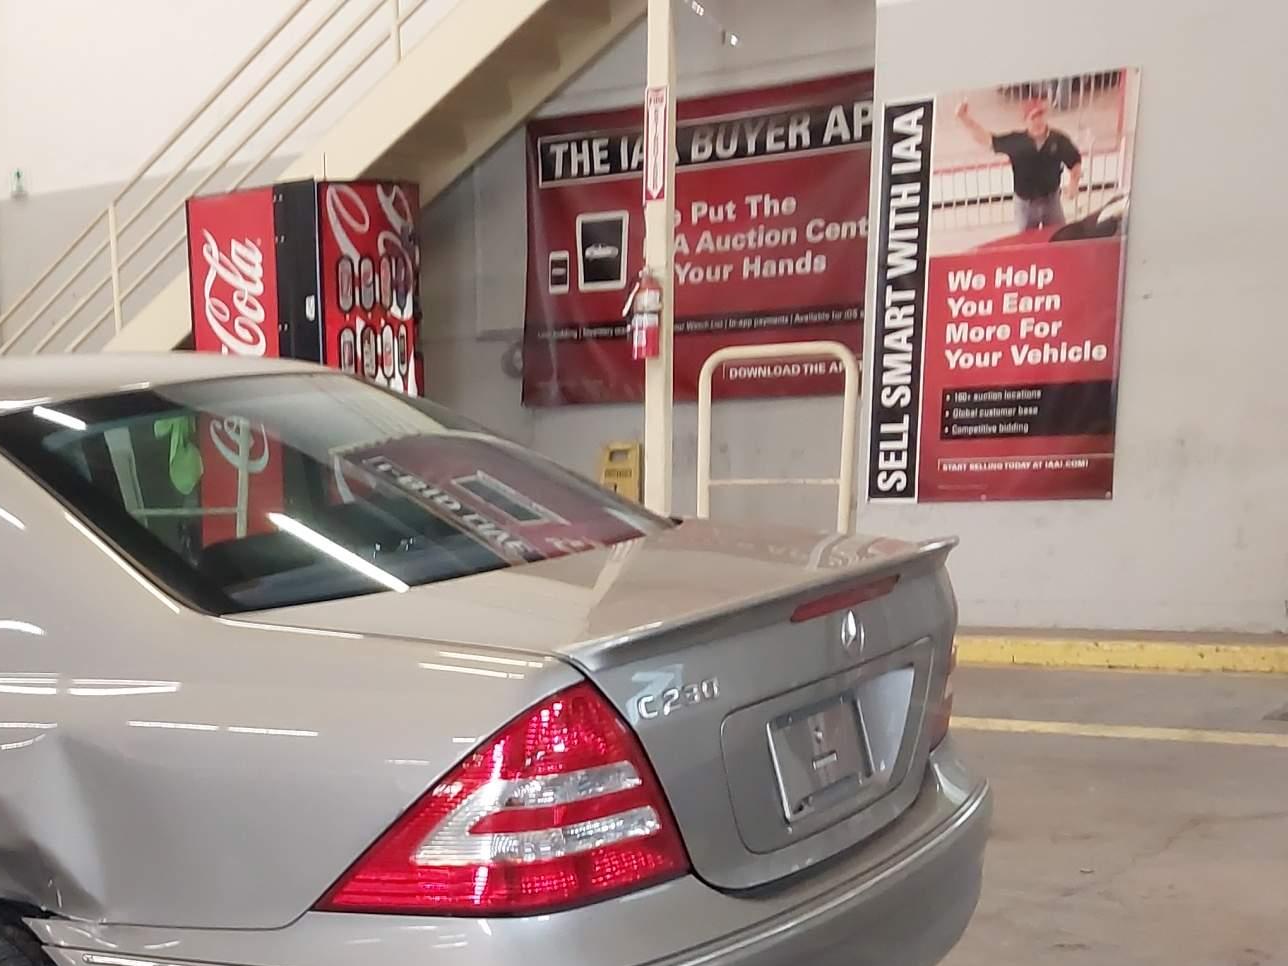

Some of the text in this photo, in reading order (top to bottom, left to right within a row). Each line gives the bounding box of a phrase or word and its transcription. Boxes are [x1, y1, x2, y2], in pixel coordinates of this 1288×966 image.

[549, 138, 611, 180] THE
[690, 112, 811, 163] BUYER
[690, 199, 737, 226] Put
[744, 193, 797, 220] The
[695, 223, 798, 255] Auction
[674, 249, 827, 286] Your Hands
[947, 264, 1054, 293] We Help
[877, 106, 925, 492] SELL SMART WITH IAA
[947, 291, 1061, 319] You Earn
[945, 317, 1063, 344] More For
[944, 340, 1108, 370] Your Vehicle
[729, 363, 801, 380] DOWNLOAD
[803, 361, 826, 375] THE
[973, 390, 1003, 402] auction
[1004, 389, 1042, 401] locations
[952, 407, 978, 420] Global
[979, 406, 1016, 418] customer
[951, 422, 1029, 436] Competitive bidding
